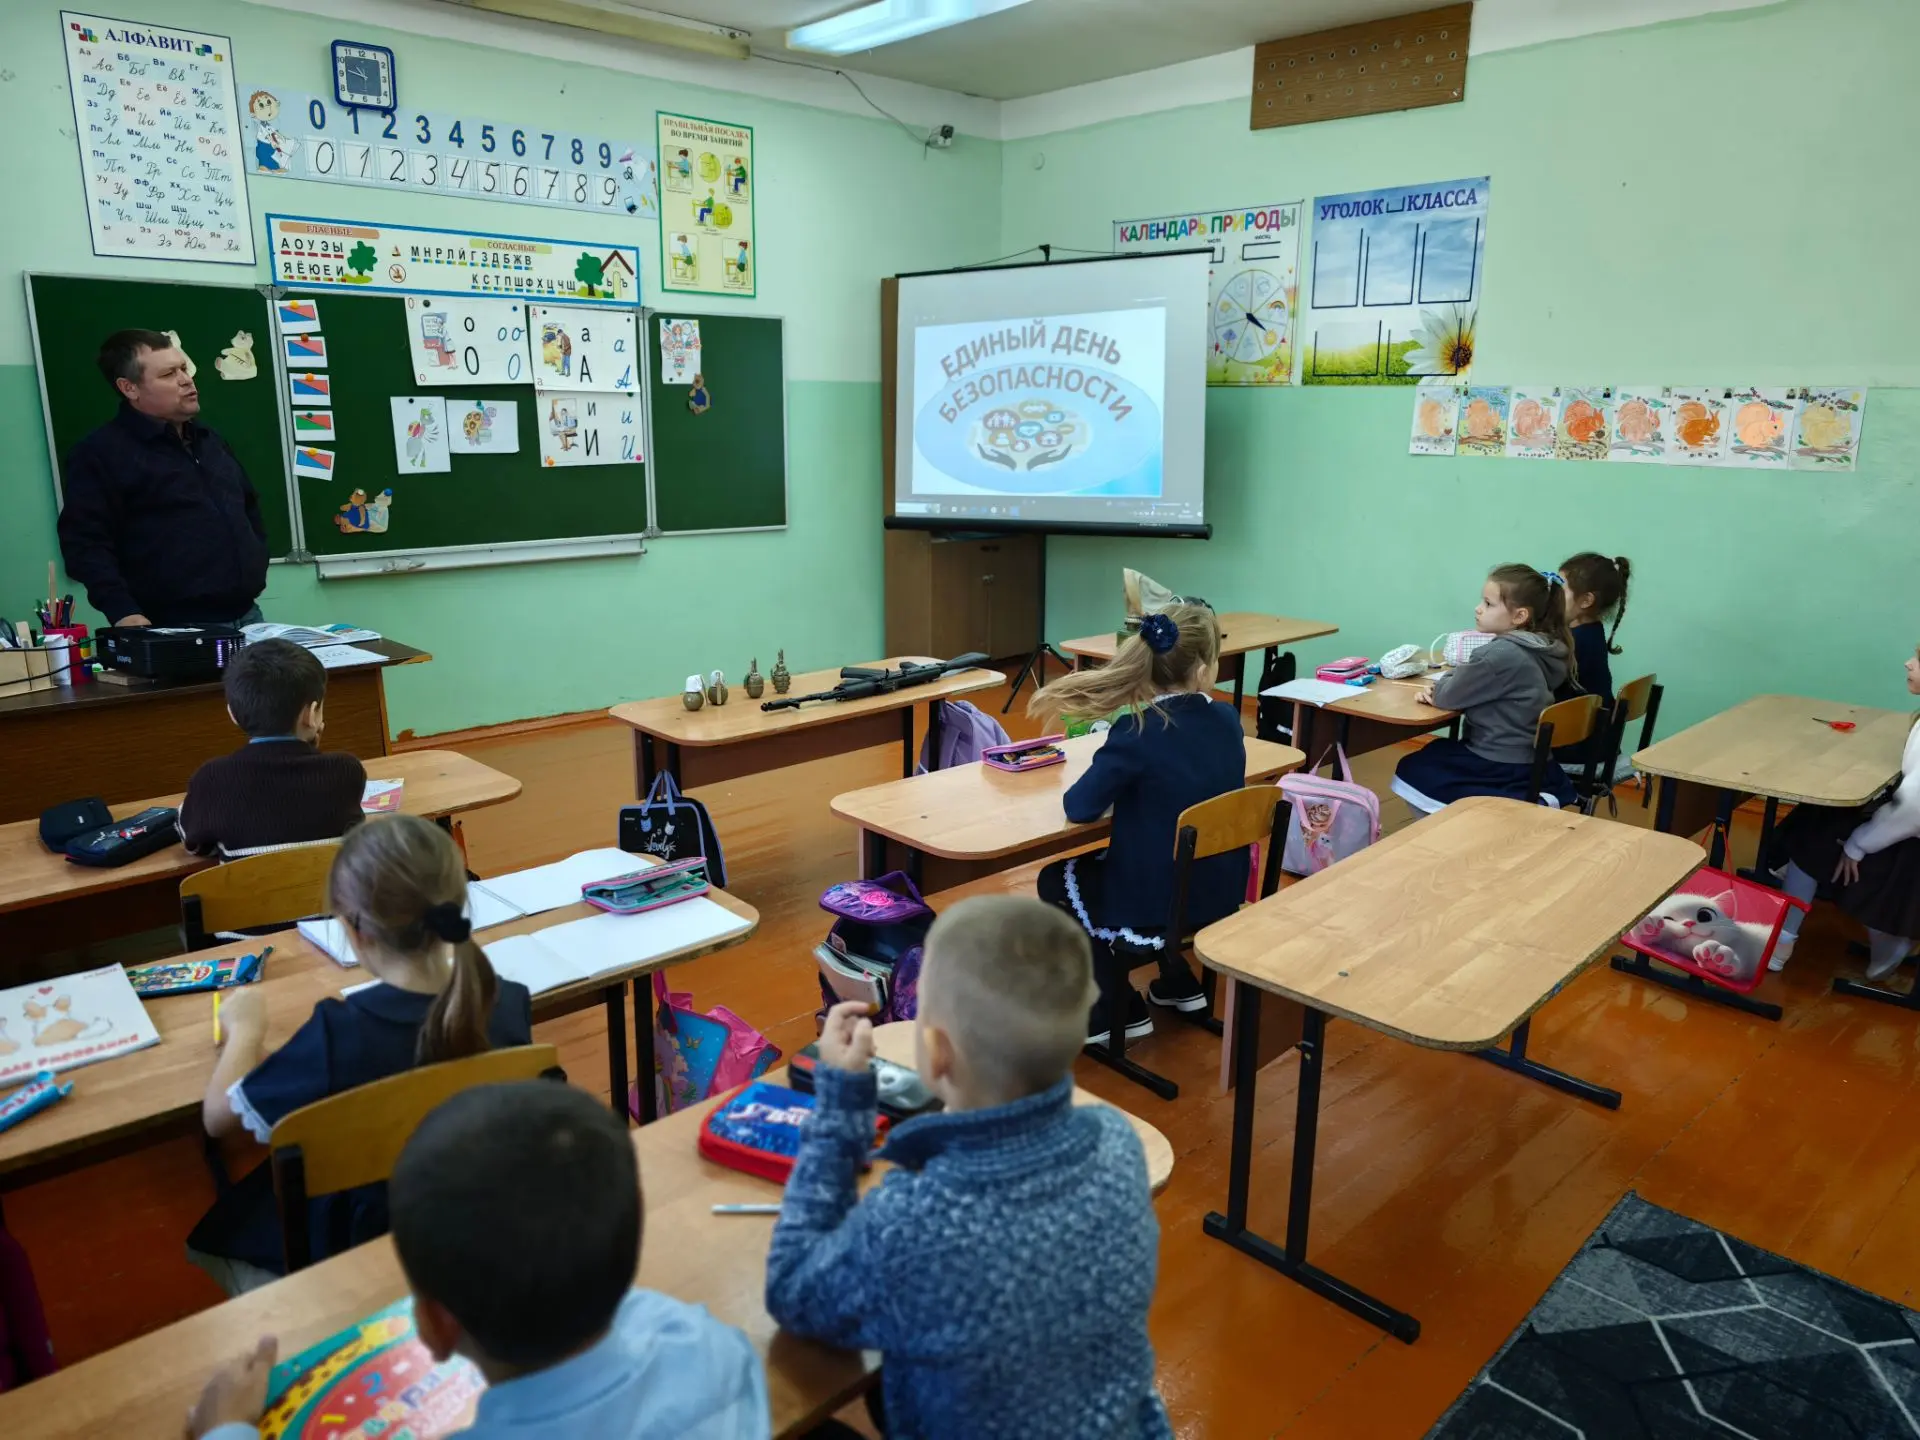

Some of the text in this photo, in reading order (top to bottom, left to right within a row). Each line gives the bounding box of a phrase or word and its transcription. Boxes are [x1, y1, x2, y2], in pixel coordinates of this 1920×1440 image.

[104, 28, 194, 53] АЛФАВИТ
[344, 48, 352, 56] 11
[339, 69, 345, 77] 9
[380, 61, 386, 69] 2
[382, 75, 387, 83] 3
[362, 95, 368, 103] 6
[382, 90, 388, 98] 4
[309, 99, 611, 169] 0 1 2 3 4 5 6 7 8 9
[663, 118, 749, 140] ПРАВИЛЬНАЯ ПОСАДКА
[670, 129, 743, 147] ВО ВРЕМЯ ЗАНЯТИЙ
[315, 141, 617, 206] 0 1 2 3 4 5 6 7 8 9
[1320, 188, 1478, 221] УГОЛОК КЛАССА
[306, 224, 353, 237] ГЛАСНЫЕ
[1119, 207, 1297, 243] КАЛЕНДАРЬ ПРИРОДЫ
[487, 240, 537, 252] СОГЛАСНЫЕ
[581, 327, 591, 342] а
[613, 338, 626, 353] а
[939, 318, 1122, 379] ЕДИНЫЙ ДЕНЬ
[579, 354, 593, 383] А
[614, 364, 632, 389] А
[938, 364, 1133, 425] БЕЗОПАСНОСТИ
[584, 428, 600, 457] И
